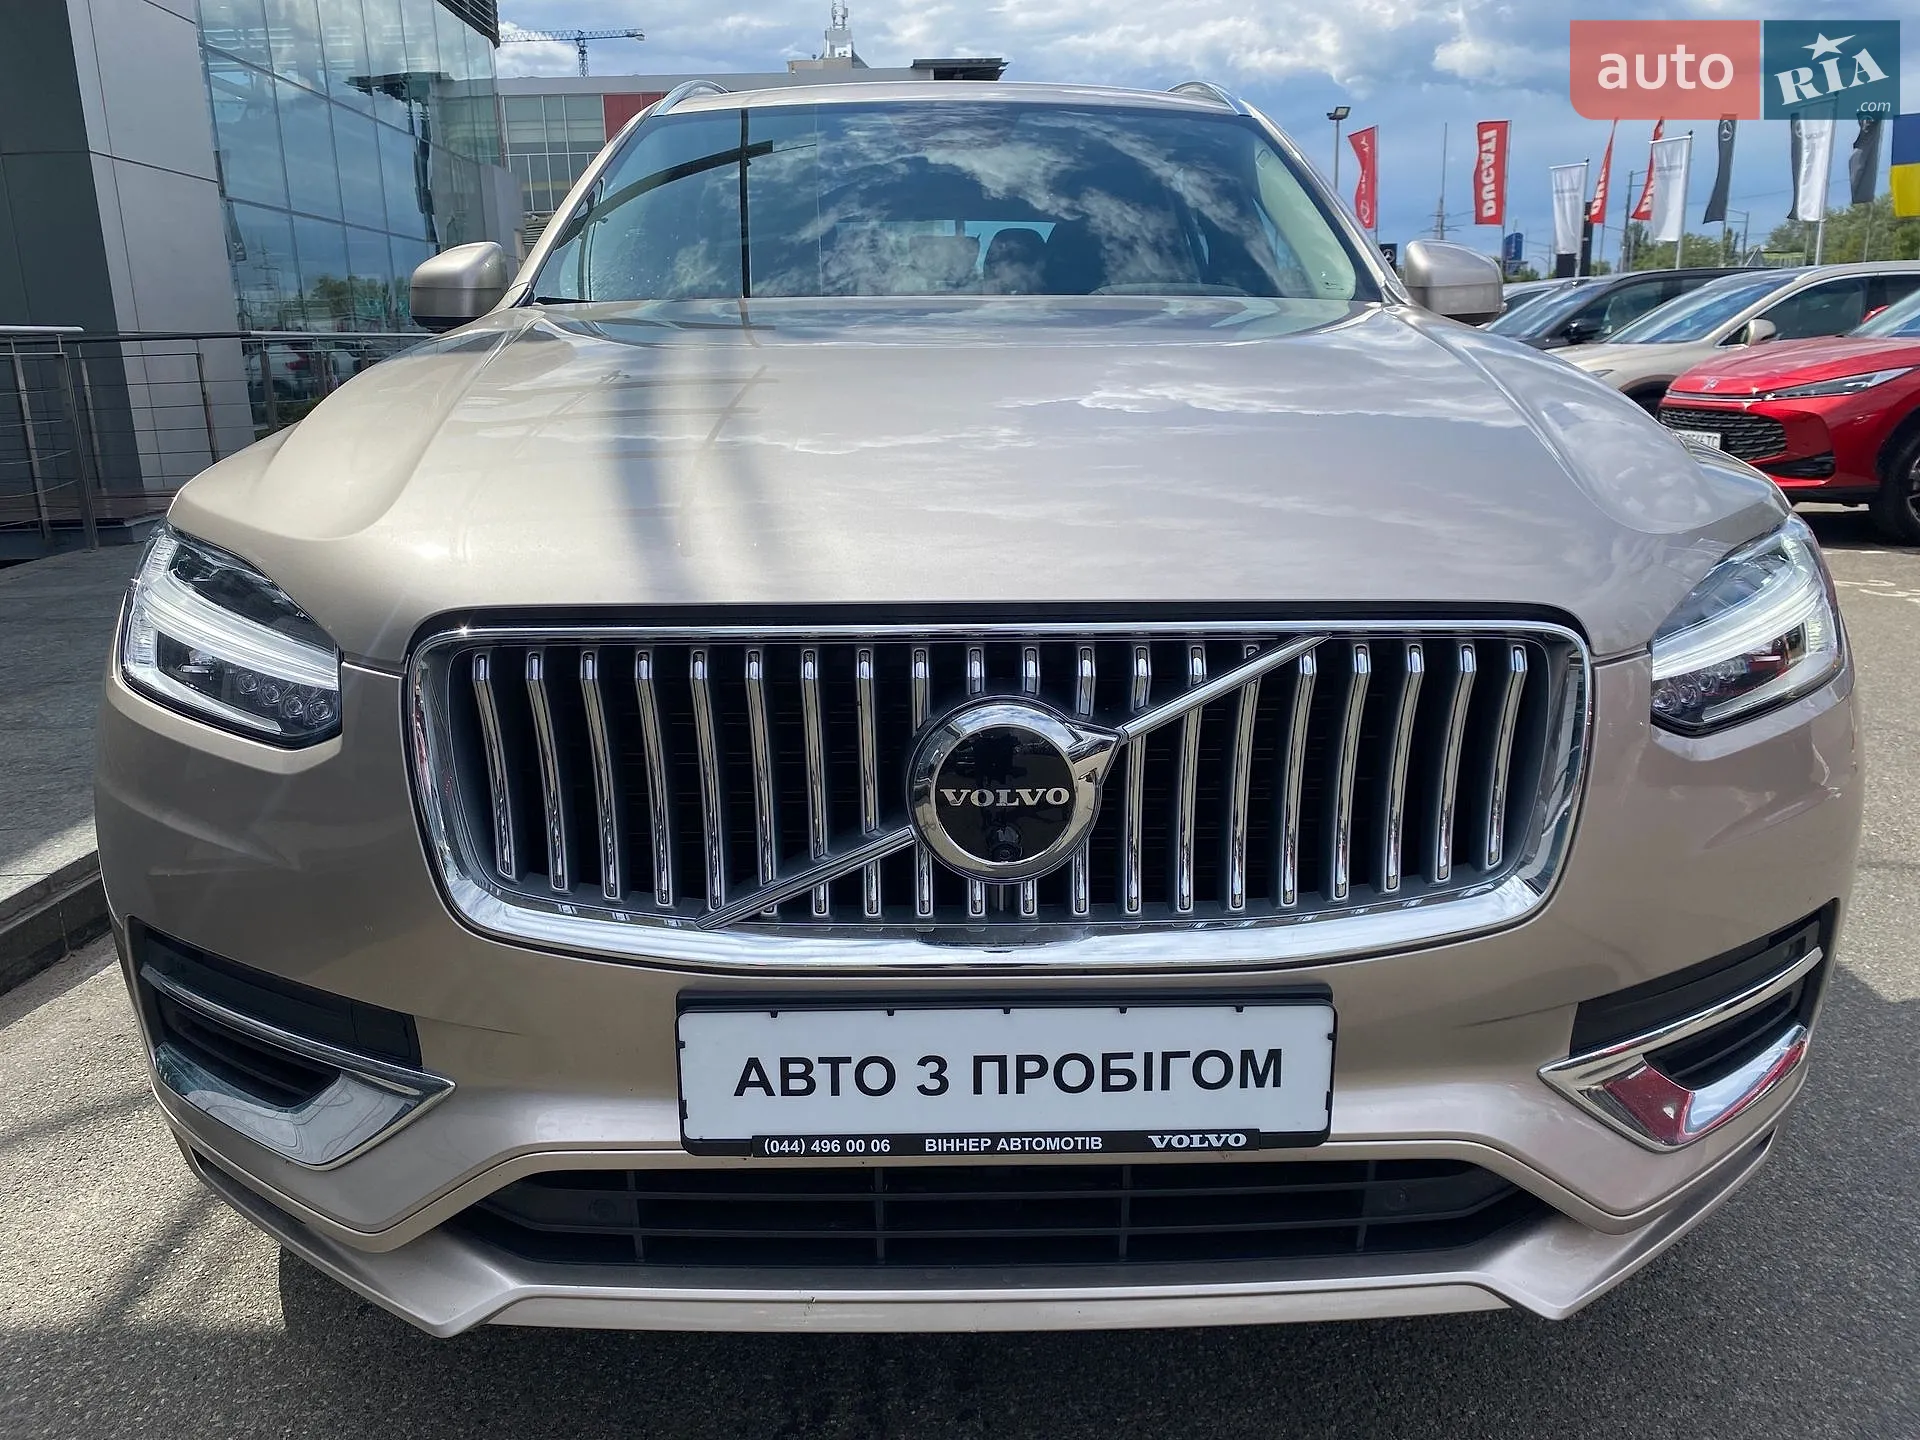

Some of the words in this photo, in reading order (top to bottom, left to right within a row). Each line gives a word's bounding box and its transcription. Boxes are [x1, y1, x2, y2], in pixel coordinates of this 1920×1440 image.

[939, 787, 1070, 807] VOLVO
[734, 1055, 896, 1097] АВТО
[917, 1054, 949, 1097] З
[972, 1048, 1283, 1096] ПРОБІГОМ
[764, 1137, 806, 1155] (044)
[811, 1138, 841, 1153] 496
[845, 1138, 865, 1153] 00
[870, 1138, 891, 1153] 06
[925, 1137, 992, 1152] ВІННЕР
[996, 1135, 1103, 1152] АВТОМОТІВ
[1148, 1133, 1248, 1149] VOLVO
